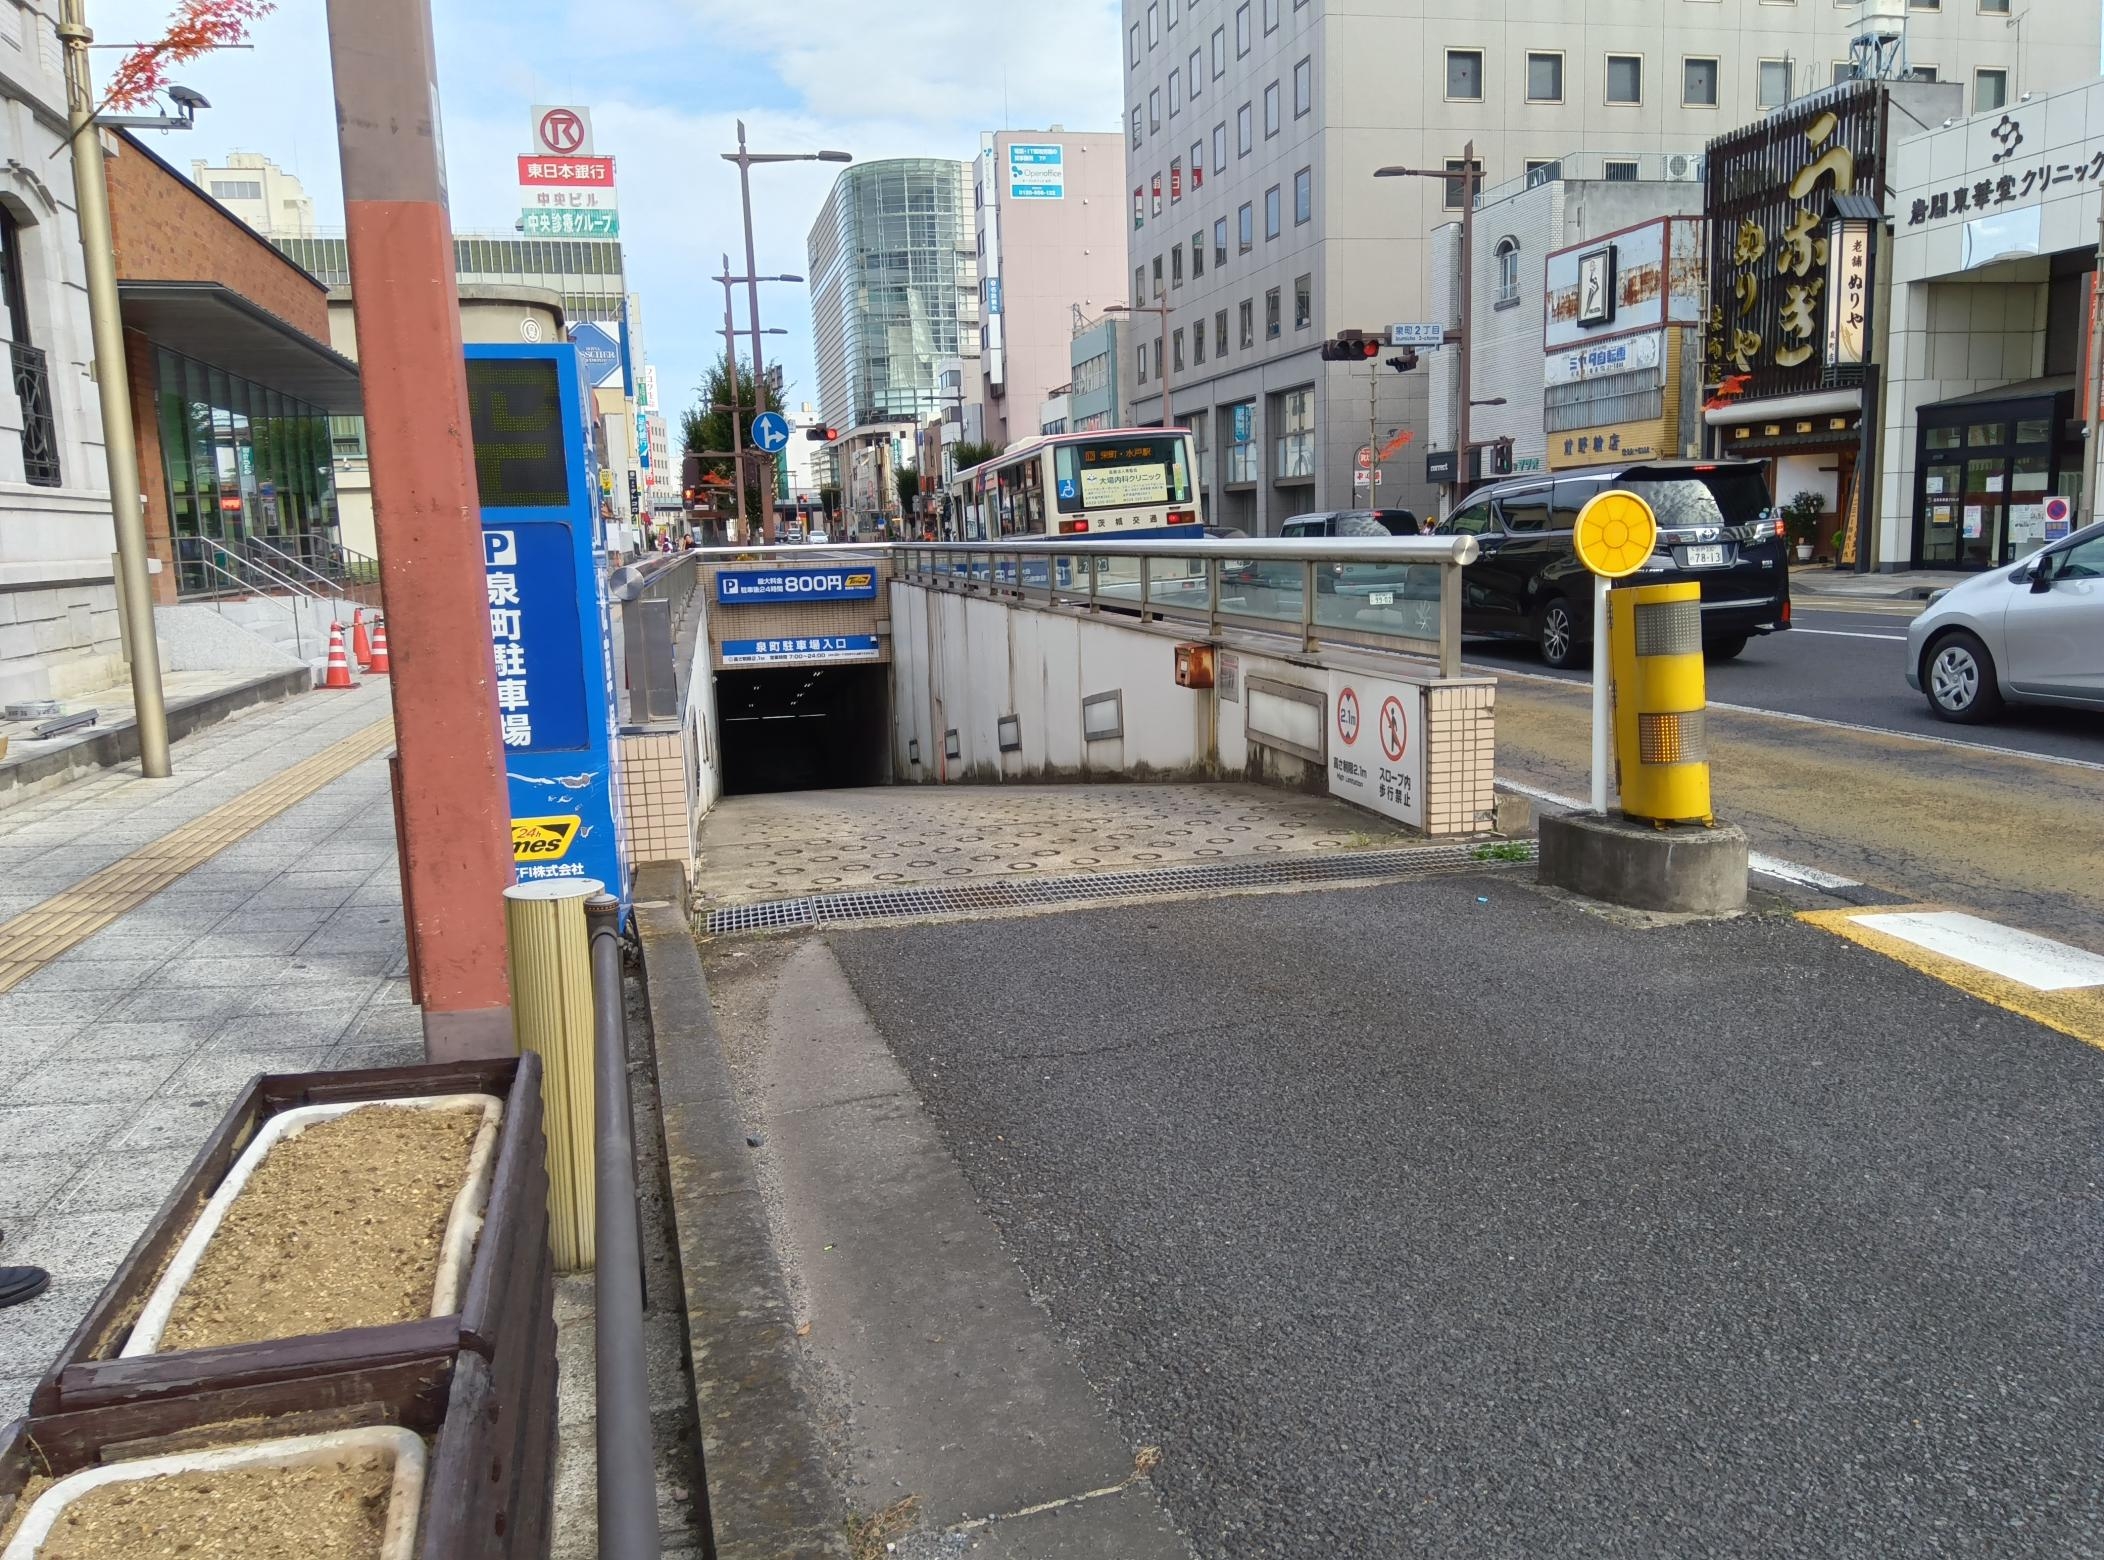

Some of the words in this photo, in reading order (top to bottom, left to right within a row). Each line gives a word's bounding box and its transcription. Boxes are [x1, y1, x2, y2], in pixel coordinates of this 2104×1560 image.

[527, 163, 606, 180] 東日本銀行
[537, 192, 599, 207] 中央ビル
[527, 212, 613, 233] 中央診療グループ
[1776, 111, 1854, 367] うなぎ
[1725, 219, 1764, 373] ぬりや
[1847, 273, 1865, 331] ぬりや
[1395, 325, 1440, 335] 泉町2丁目
[1097, 514, 1158, 528] 茨城交通
[785, 575, 842, 592] 800円
[756, 638, 847, 653] 泉町駐車場入口
[486, 571, 532, 748] 泉町駐車場
[1340, 708, 1356, 726] 2.1m
[1379, 767, 1411, 791] スロープ内
[1379, 783, 1411, 808] 歩行禁止
